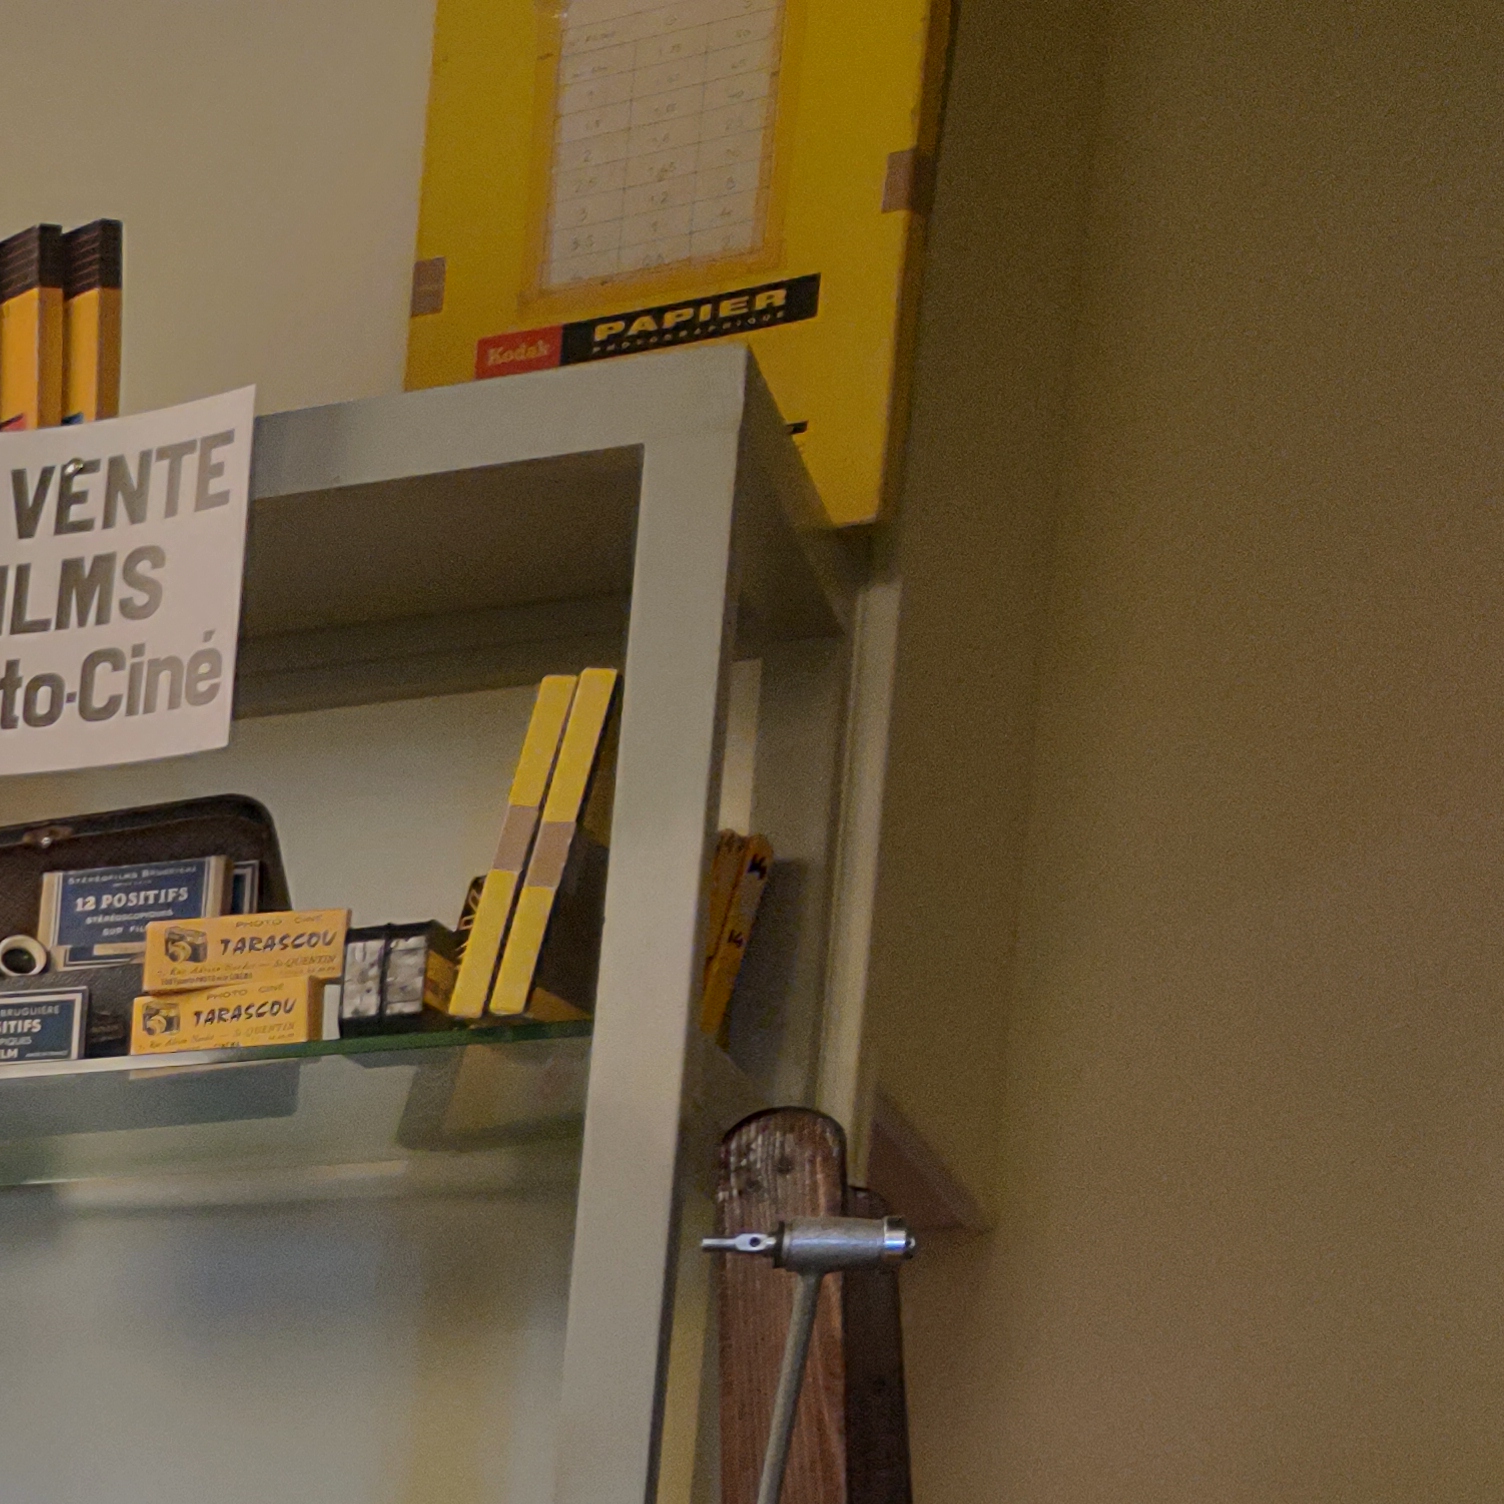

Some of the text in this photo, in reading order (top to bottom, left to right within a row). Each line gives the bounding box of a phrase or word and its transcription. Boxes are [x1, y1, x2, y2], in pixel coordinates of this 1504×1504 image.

[593, 288, 788, 342] PAPIER
[10, 428, 236, 541] VENTE
[75, 886, 189, 912] 12 POSITIFS
[129, 923, 148, 933] FIL
[235, 917, 283, 928] PHOTO
[220, 929, 338, 956] TARASCOU
[193, 998, 298, 1027] TARASCOU
